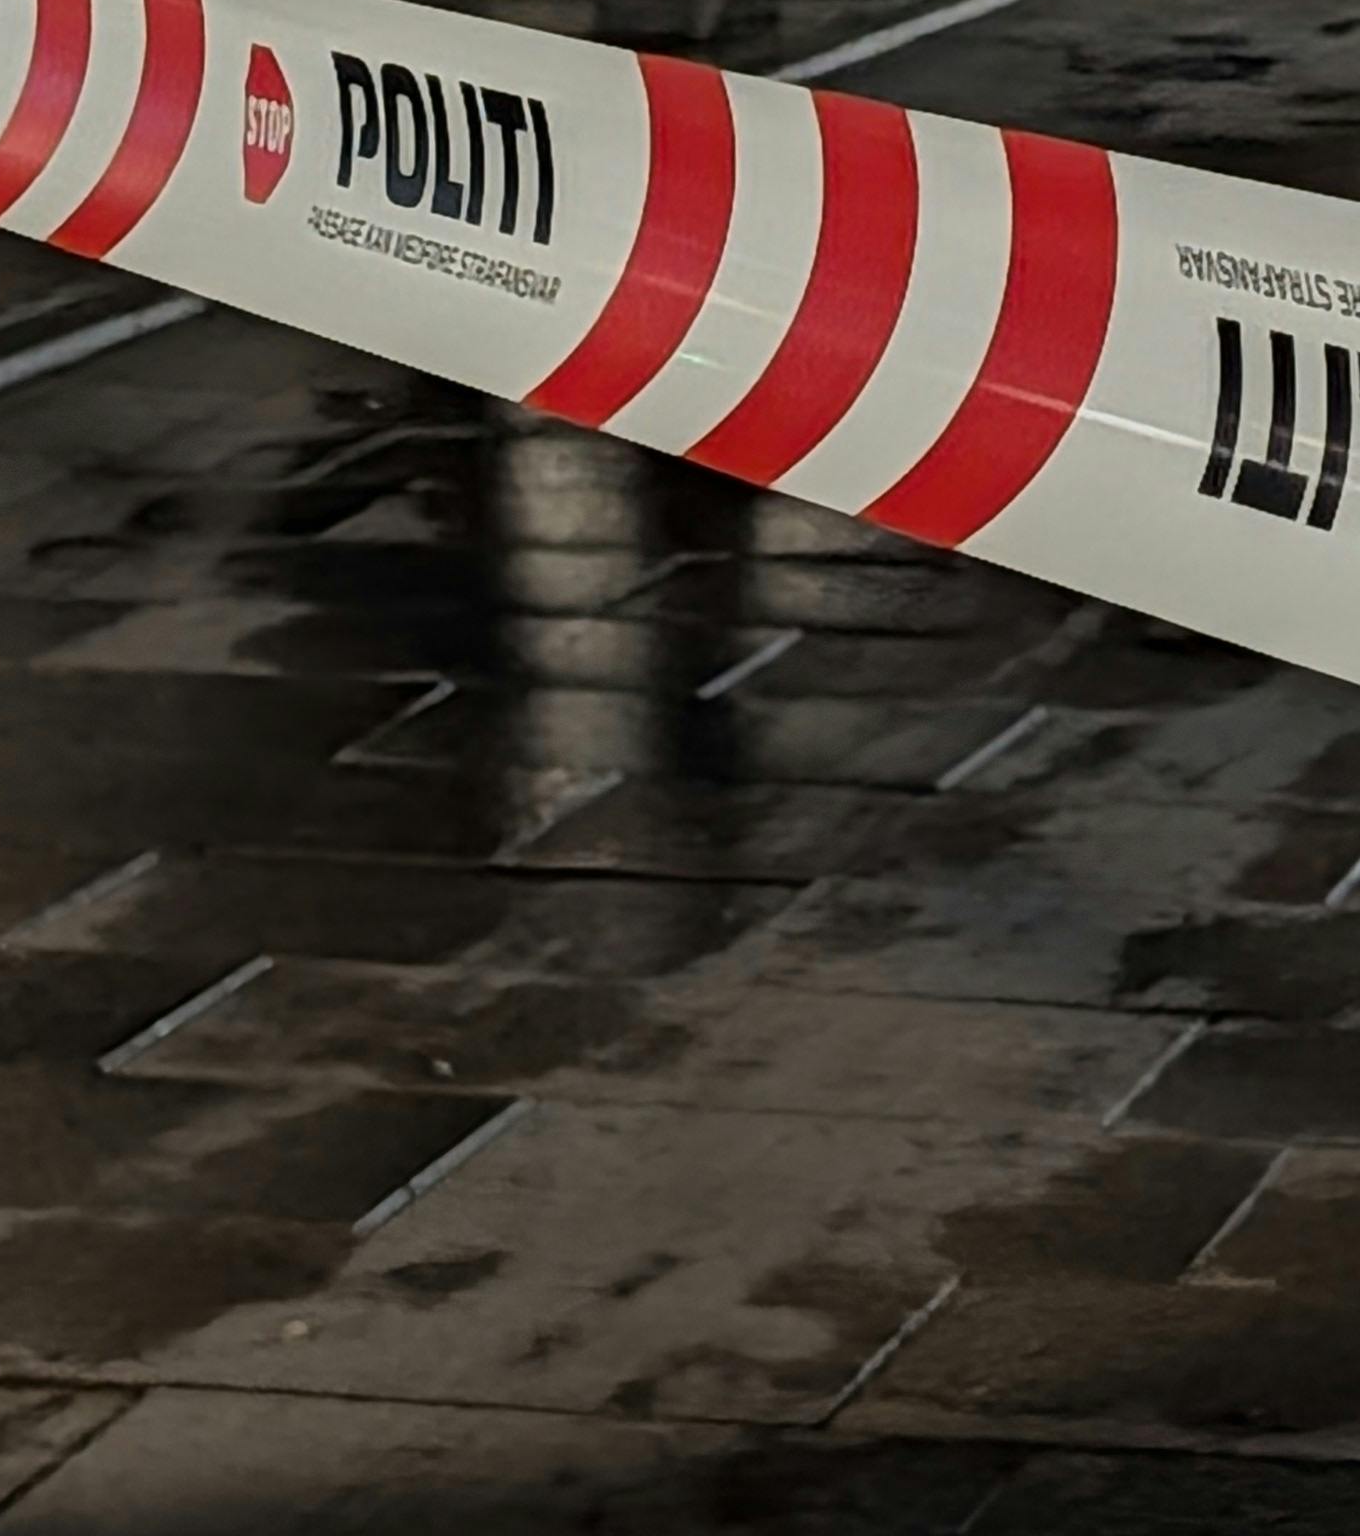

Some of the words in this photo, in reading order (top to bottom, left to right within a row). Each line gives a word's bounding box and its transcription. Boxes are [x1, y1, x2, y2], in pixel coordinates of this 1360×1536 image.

[246, 94, 290, 155] STOP
[330, 49, 555, 246] POLITI
[1175, 243, 1333, 312] STRAFANSVAR
